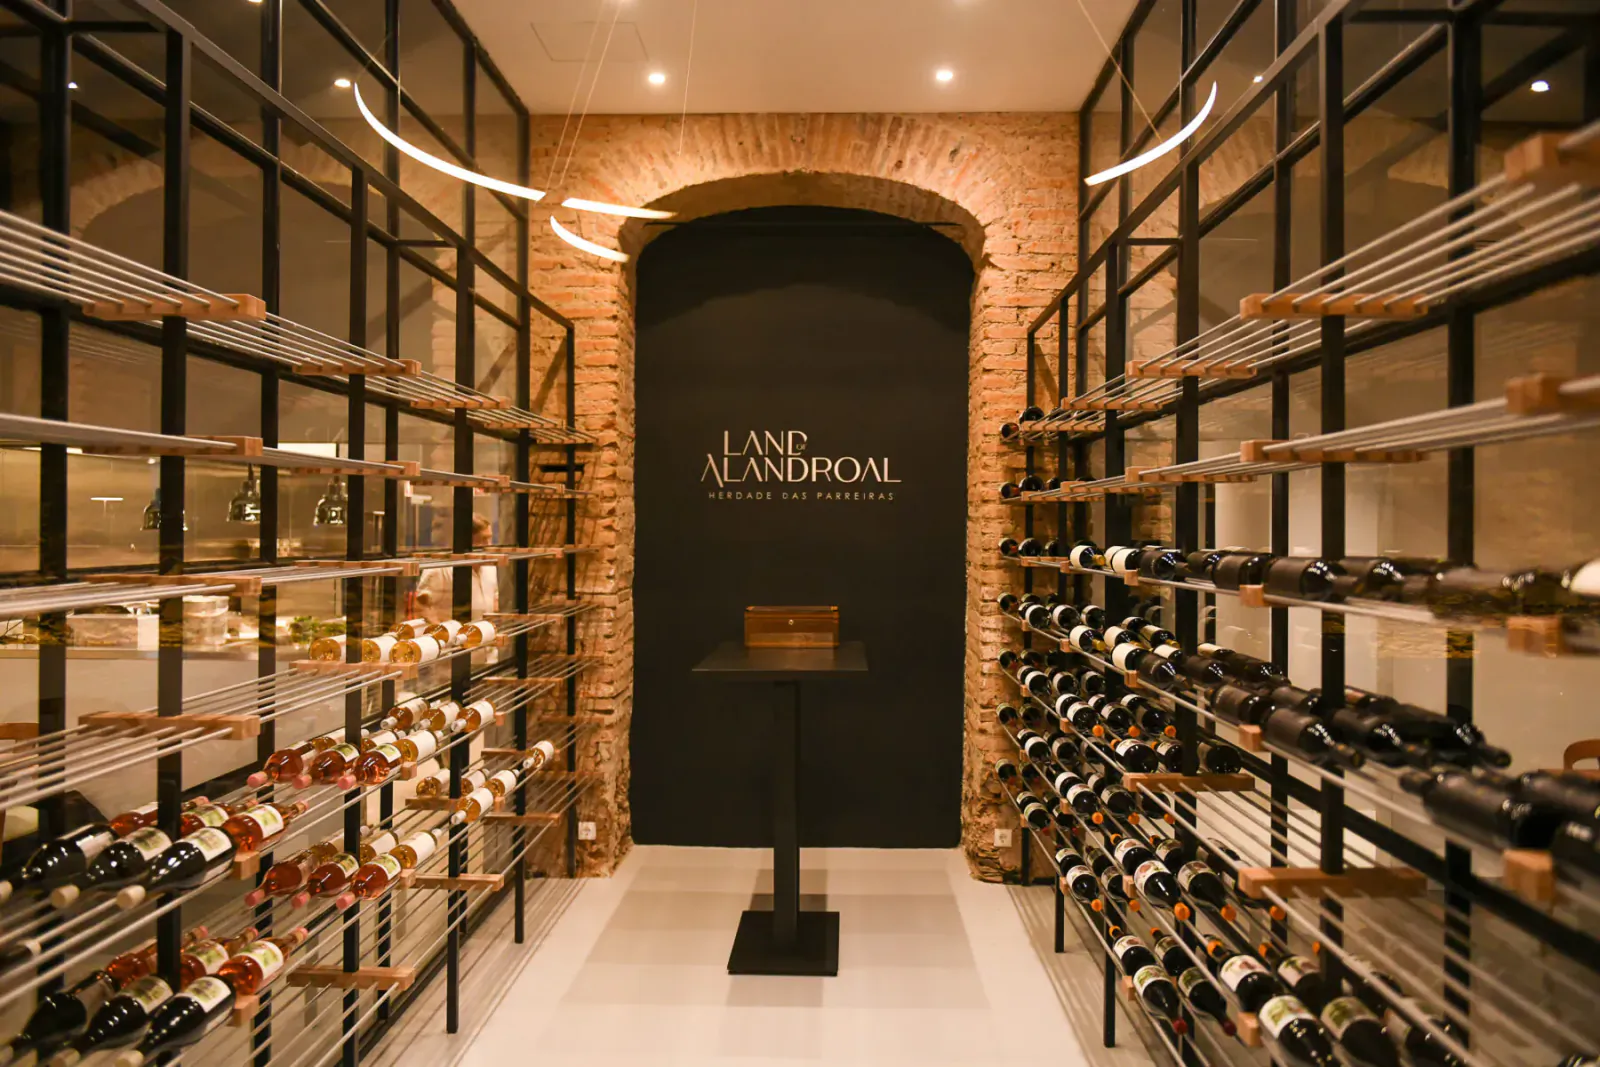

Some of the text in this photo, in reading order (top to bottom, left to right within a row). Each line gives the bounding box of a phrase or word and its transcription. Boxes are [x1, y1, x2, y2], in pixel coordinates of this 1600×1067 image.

[723, 430, 808, 456] LAND
[700, 453, 903, 488] ALANDROAL
[708, 491, 894, 501] HERDADE DAS PARREIRAS
